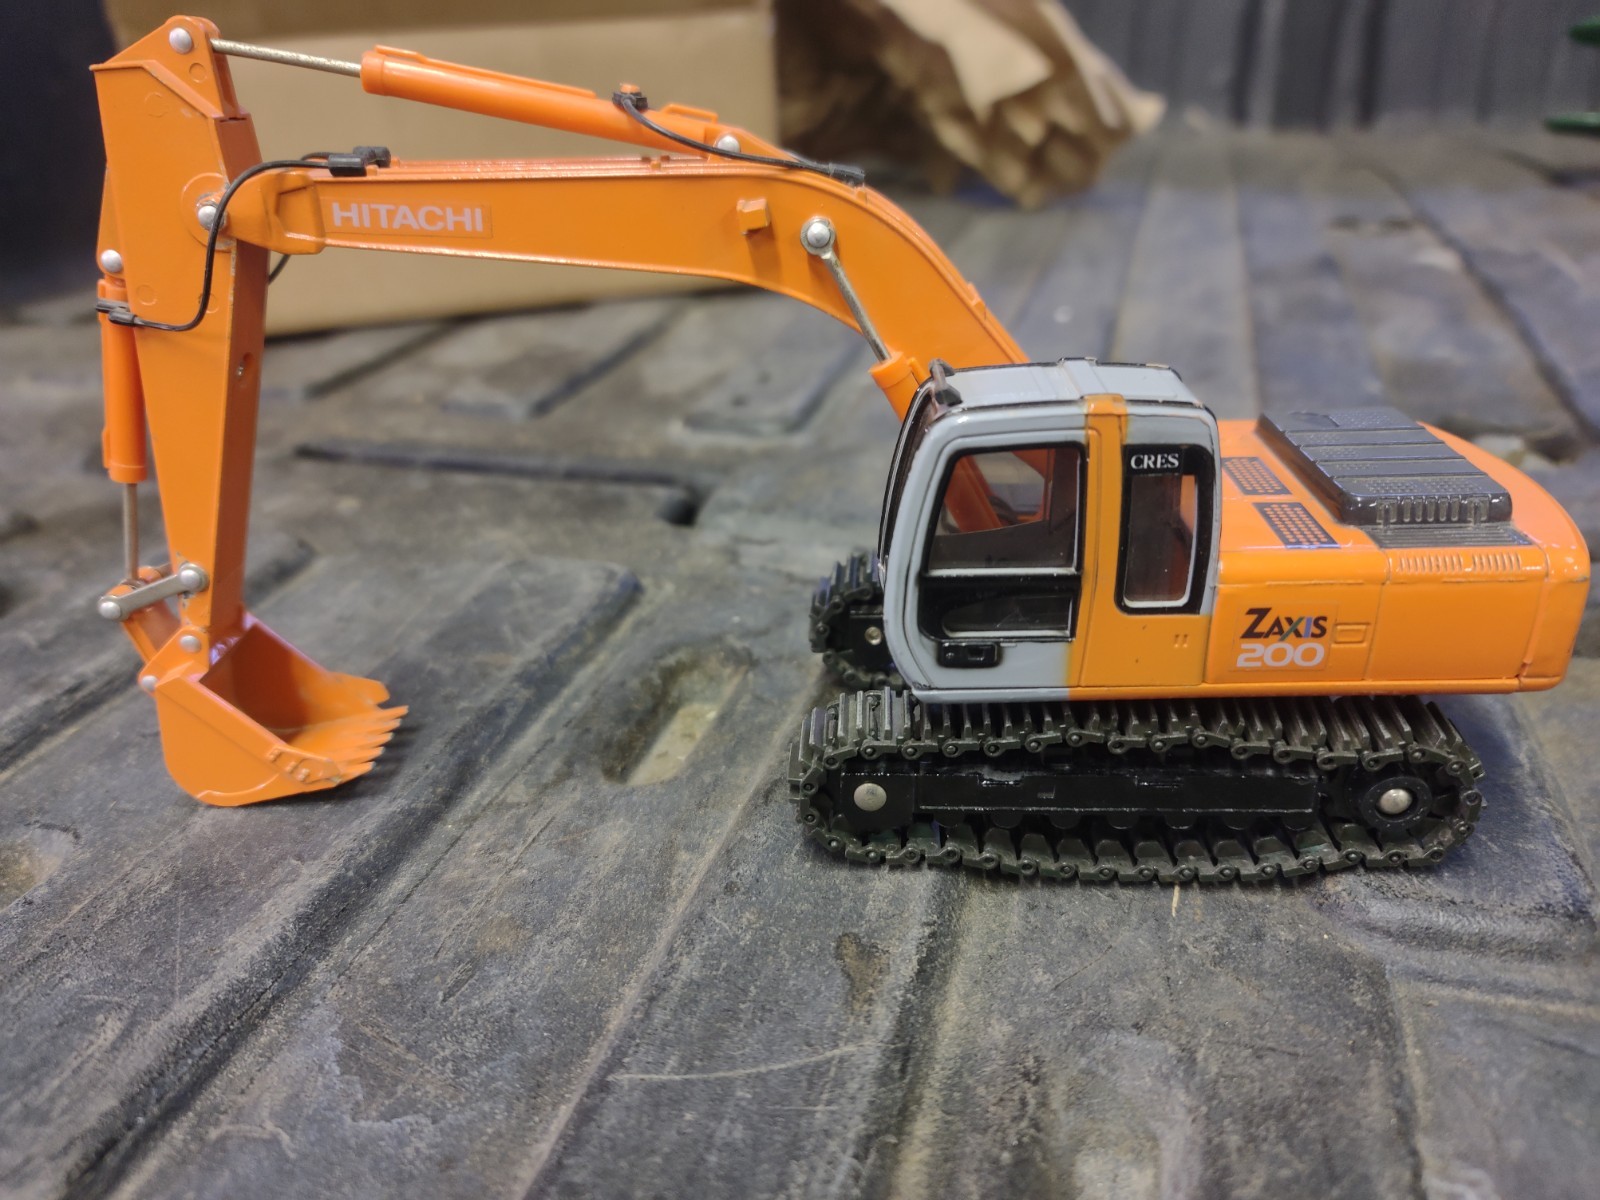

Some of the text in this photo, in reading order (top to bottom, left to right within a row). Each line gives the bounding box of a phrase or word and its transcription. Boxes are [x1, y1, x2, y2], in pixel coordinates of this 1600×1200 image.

[332, 202, 483, 232] HITACHI
[1130, 453, 1179, 469] CRES
[1240, 607, 1328, 642] ZAXIS
[1236, 642, 1325, 667] 200
